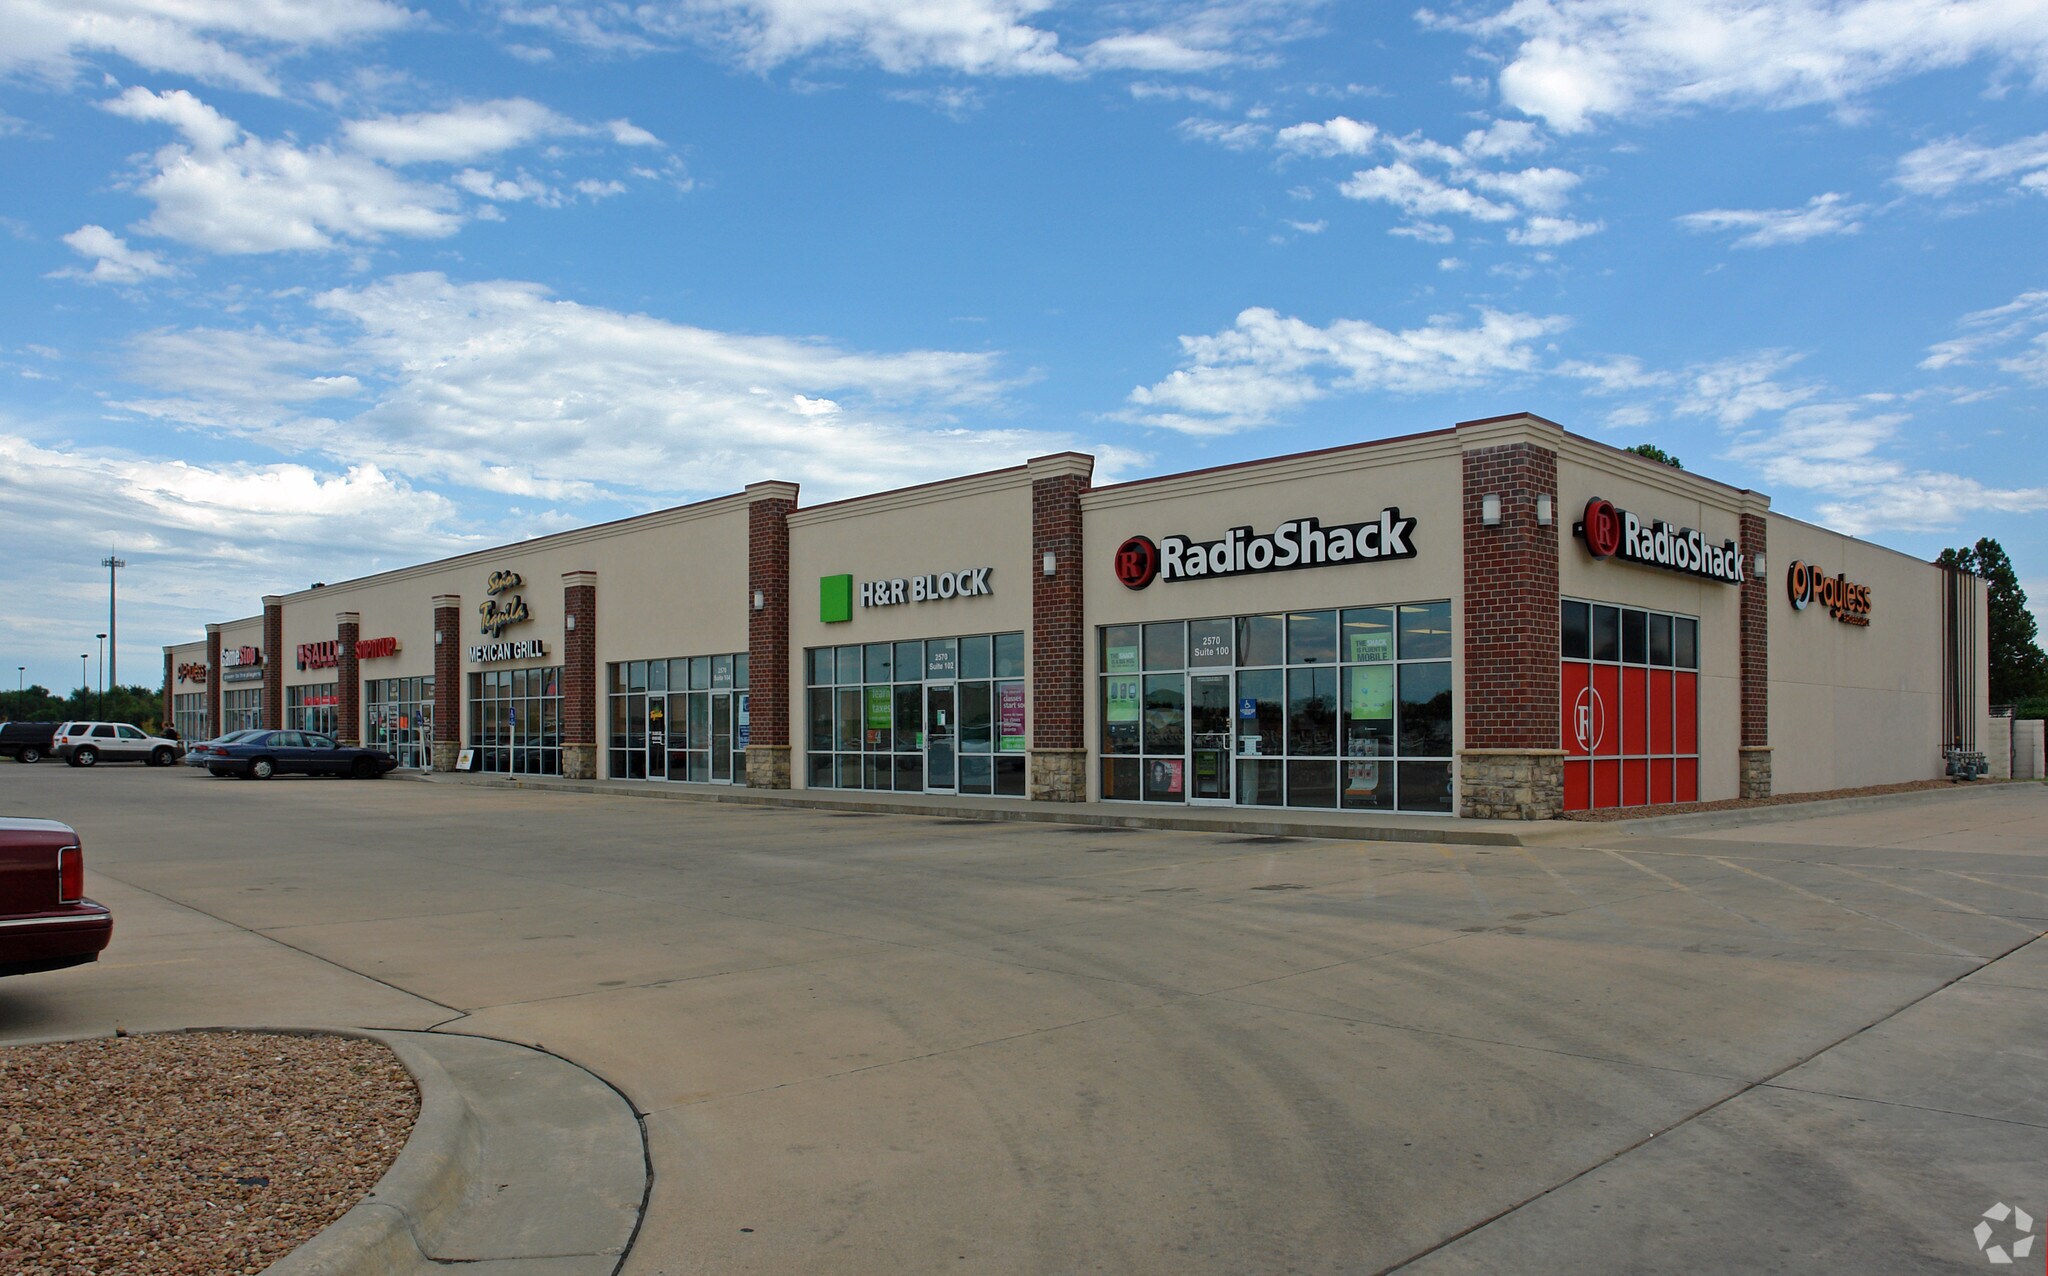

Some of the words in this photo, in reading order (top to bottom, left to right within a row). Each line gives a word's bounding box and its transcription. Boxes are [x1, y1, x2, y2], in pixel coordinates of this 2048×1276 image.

[1160, 510, 1408, 579] RadioShack
[1625, 511, 1745, 582] RadioShack
[860, 578, 909, 607] H&R
[912, 567, 993, 602] BLOCK
[1812, 564, 1872, 619] Payless
[479, 595, 529, 638] Tequila
[1202, 636, 1221, 646] 2570
[1356, 639, 1367, 647] THE
[1367, 638, 1387, 646] SHACK
[221, 646, 258, 667] GameStop
[469, 643, 512, 663] MEXICAN
[513, 640, 543, 658] GRILL
[935, 653, 948, 661] 2570
[1194, 648, 1214, 657] Suite
[1215, 646, 1229, 656] 100
[1356, 652, 1387, 662] MOBILE
[929, 662, 943, 671] Suite
[944, 661, 954, 670] 102
[872, 689, 890, 698] learn
[872, 704, 891, 713] taxes
